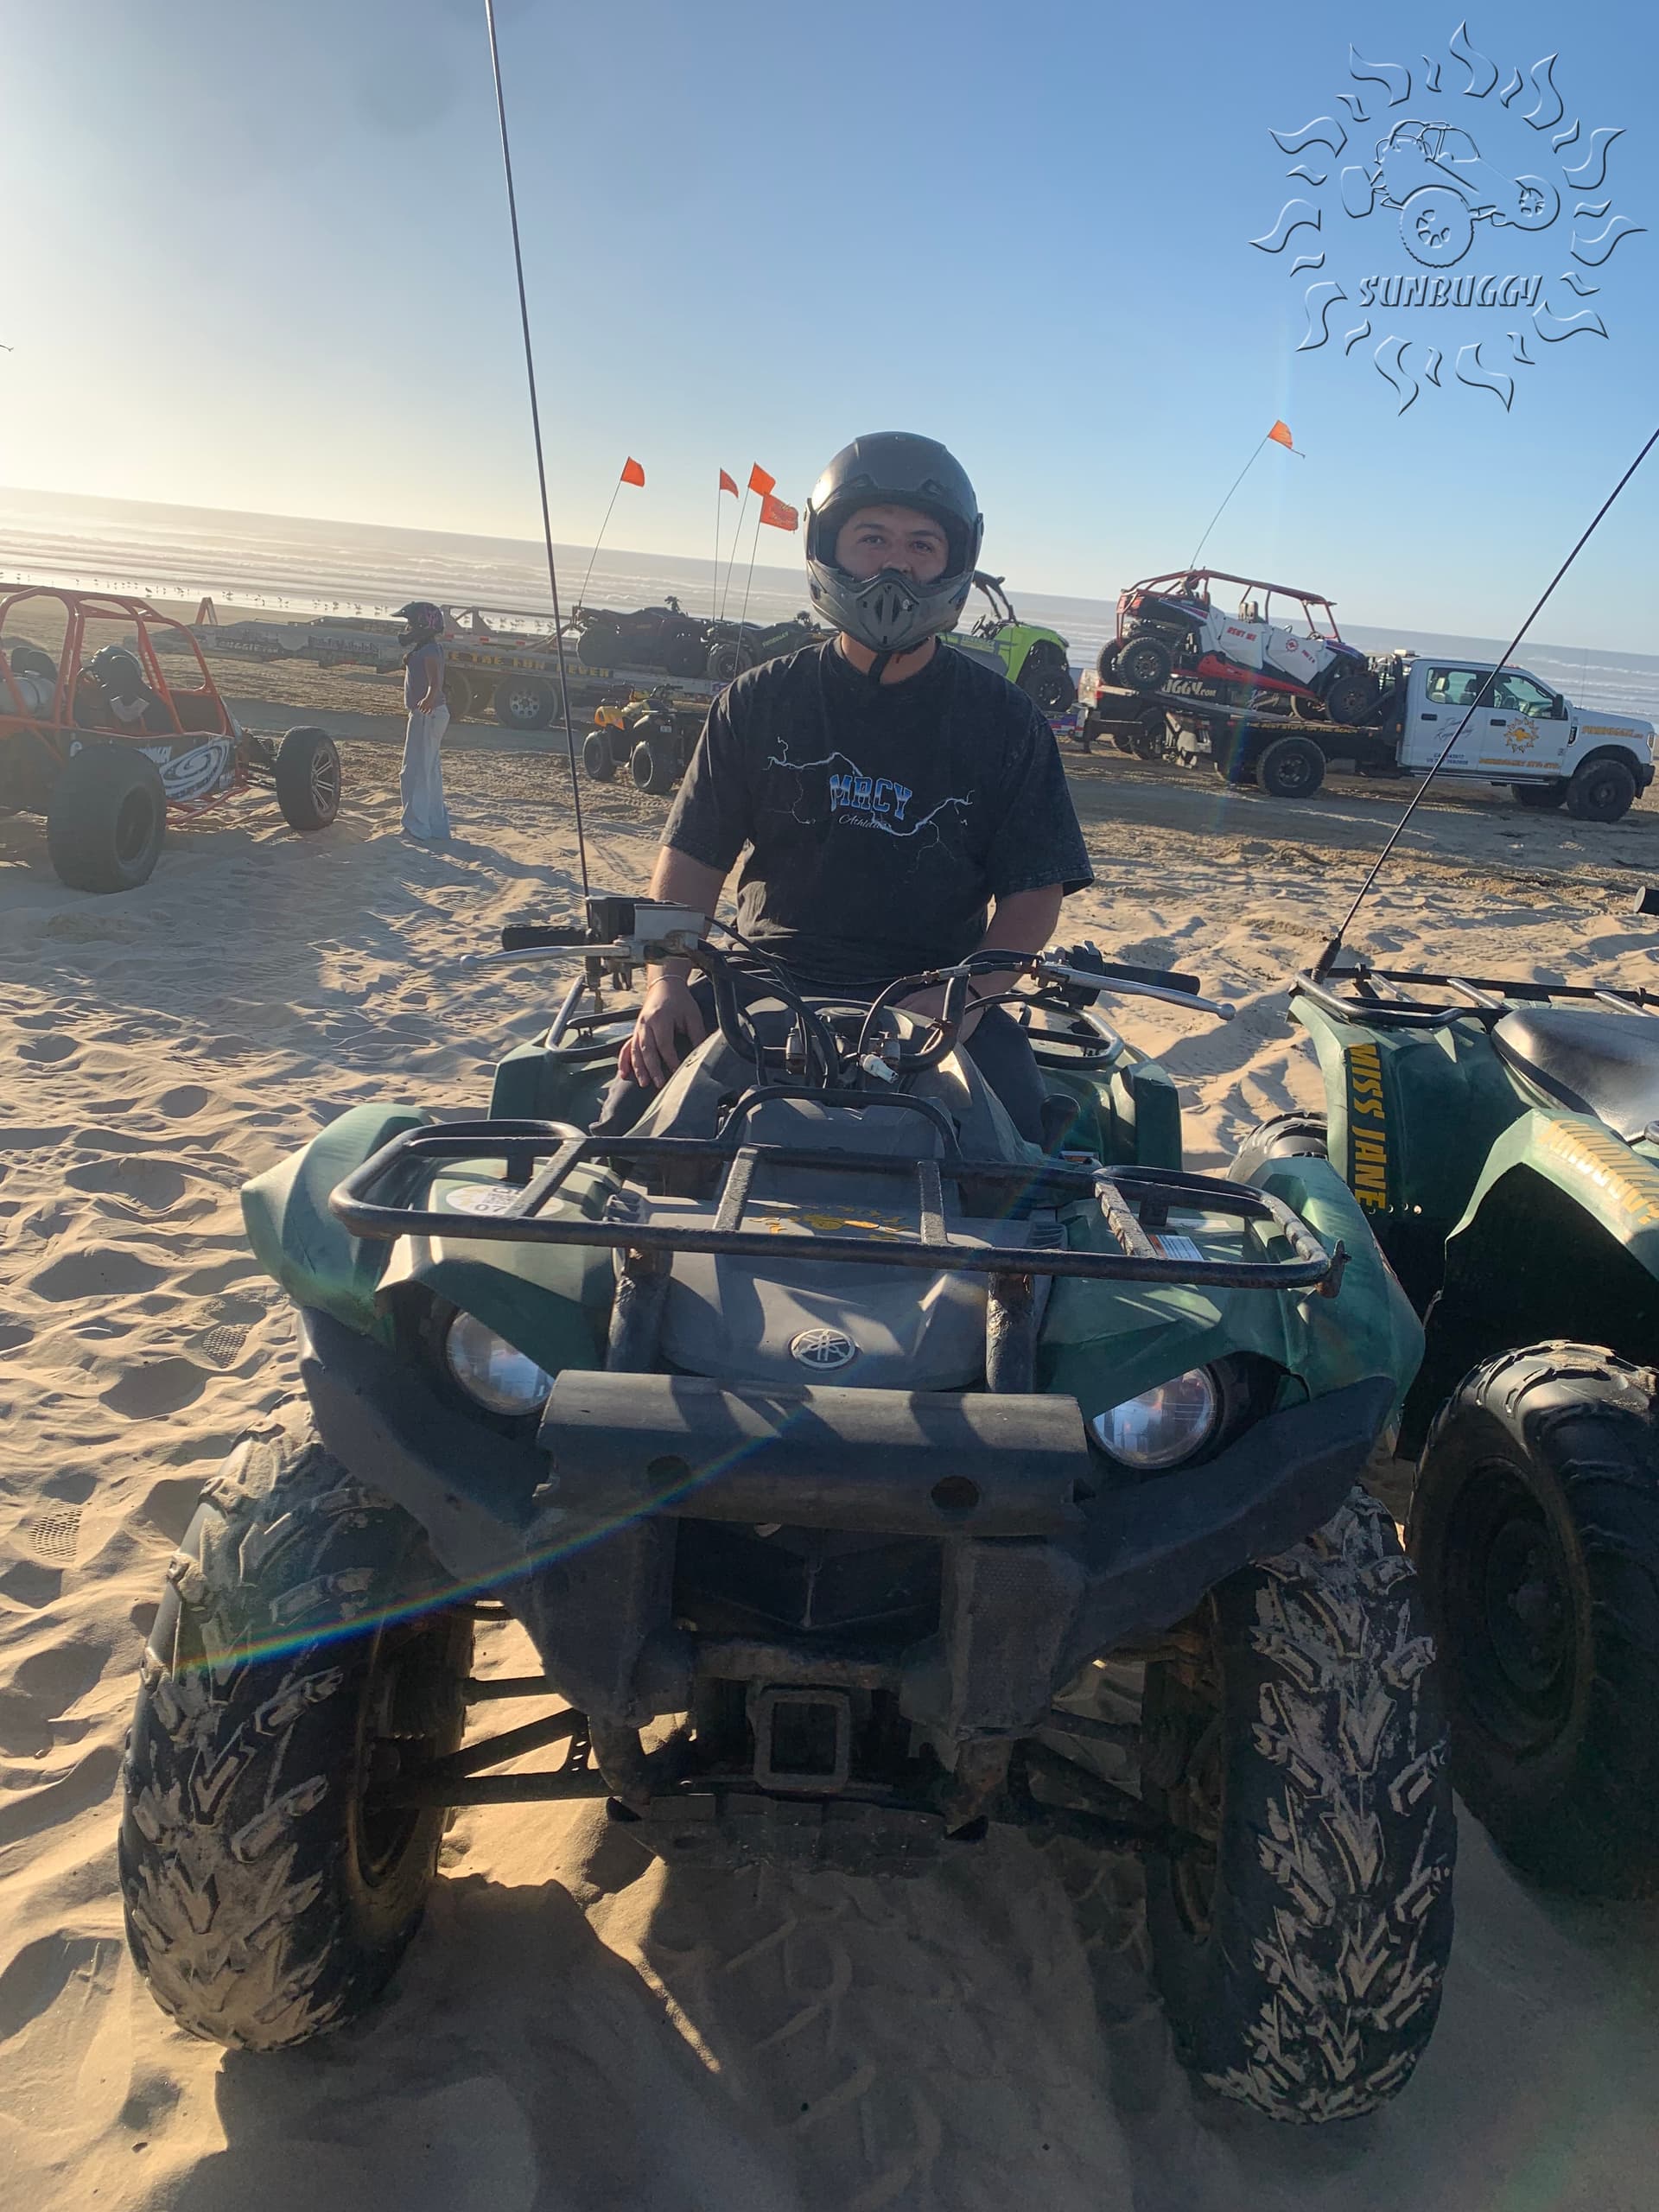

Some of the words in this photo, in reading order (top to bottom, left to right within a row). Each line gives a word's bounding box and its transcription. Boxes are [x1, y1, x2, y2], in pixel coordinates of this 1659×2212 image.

[470, 651, 505, 664] THE
[512, 655, 546, 670] FUN
[830, 774, 912, 821] MRCY
[1347, 1043, 1386, 1120] MISS
[1351, 1125, 1387, 1211] JANE
